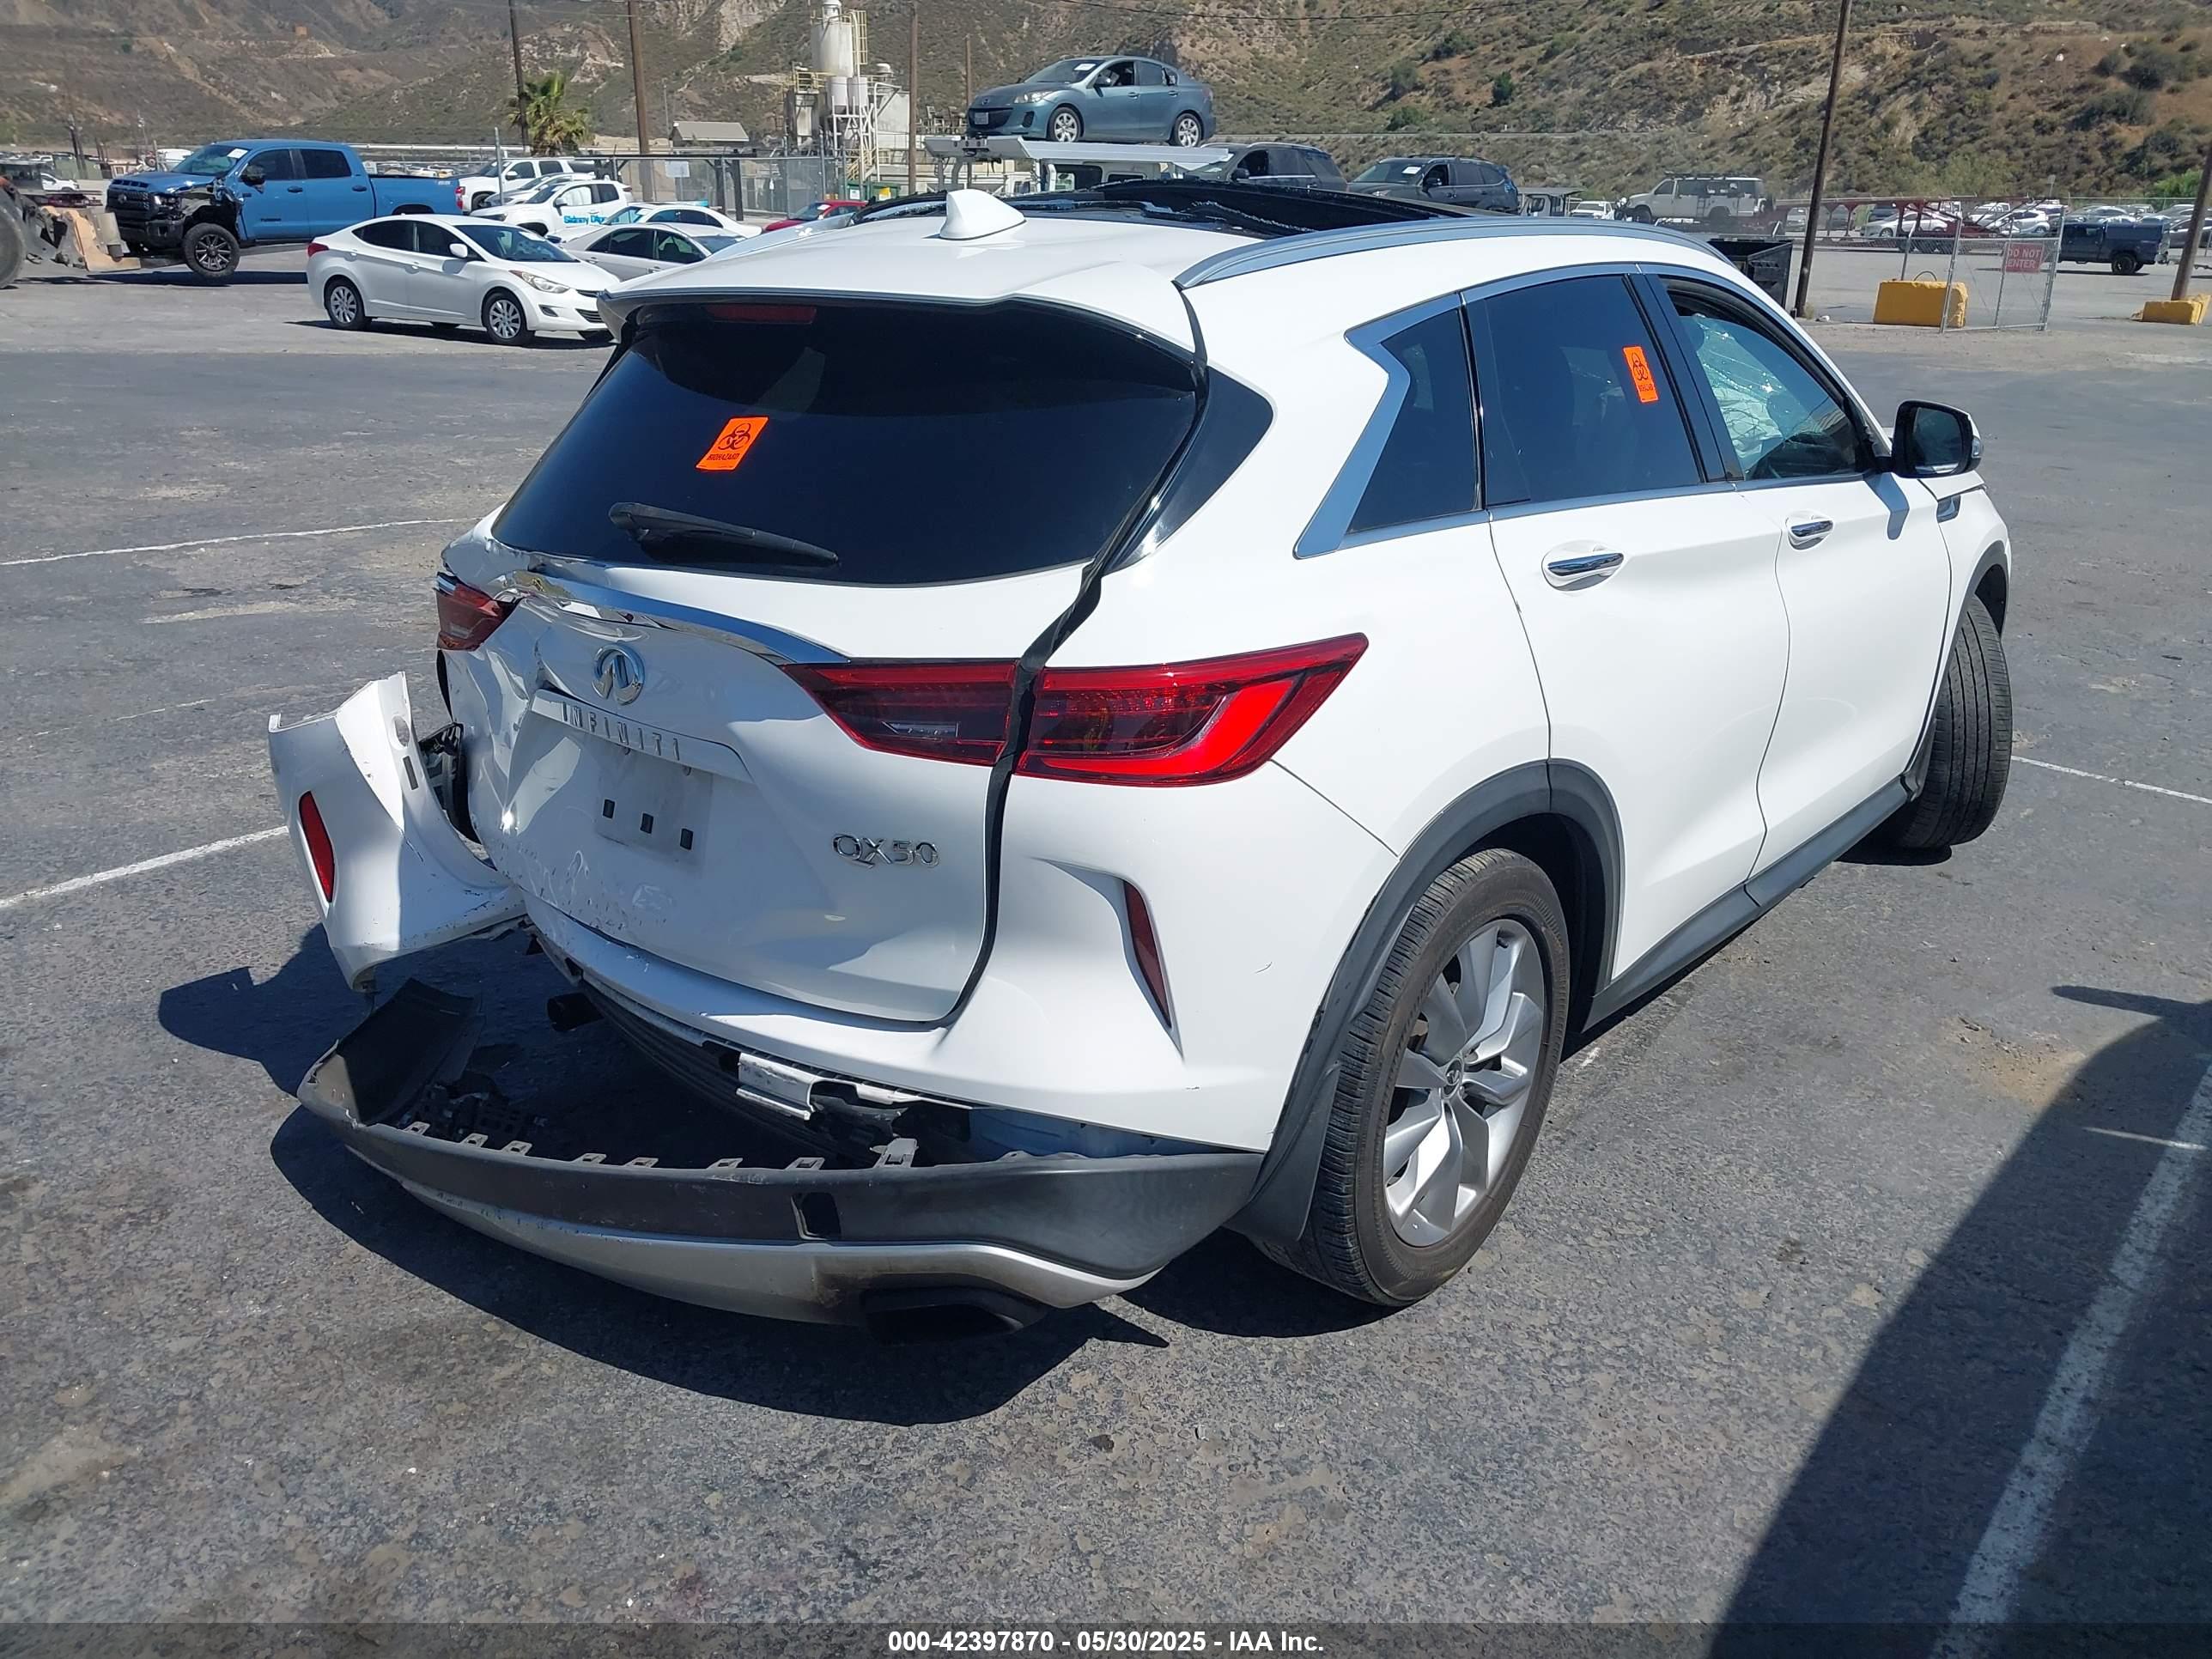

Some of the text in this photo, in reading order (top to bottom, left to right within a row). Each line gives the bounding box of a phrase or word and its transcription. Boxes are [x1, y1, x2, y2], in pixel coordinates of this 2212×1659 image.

[2008, 258, 2036, 269] ENTER
[2021, 248, 2041, 258] NOT
[561, 701, 680, 762] INFINITI
[832, 833, 939, 869] QX50
